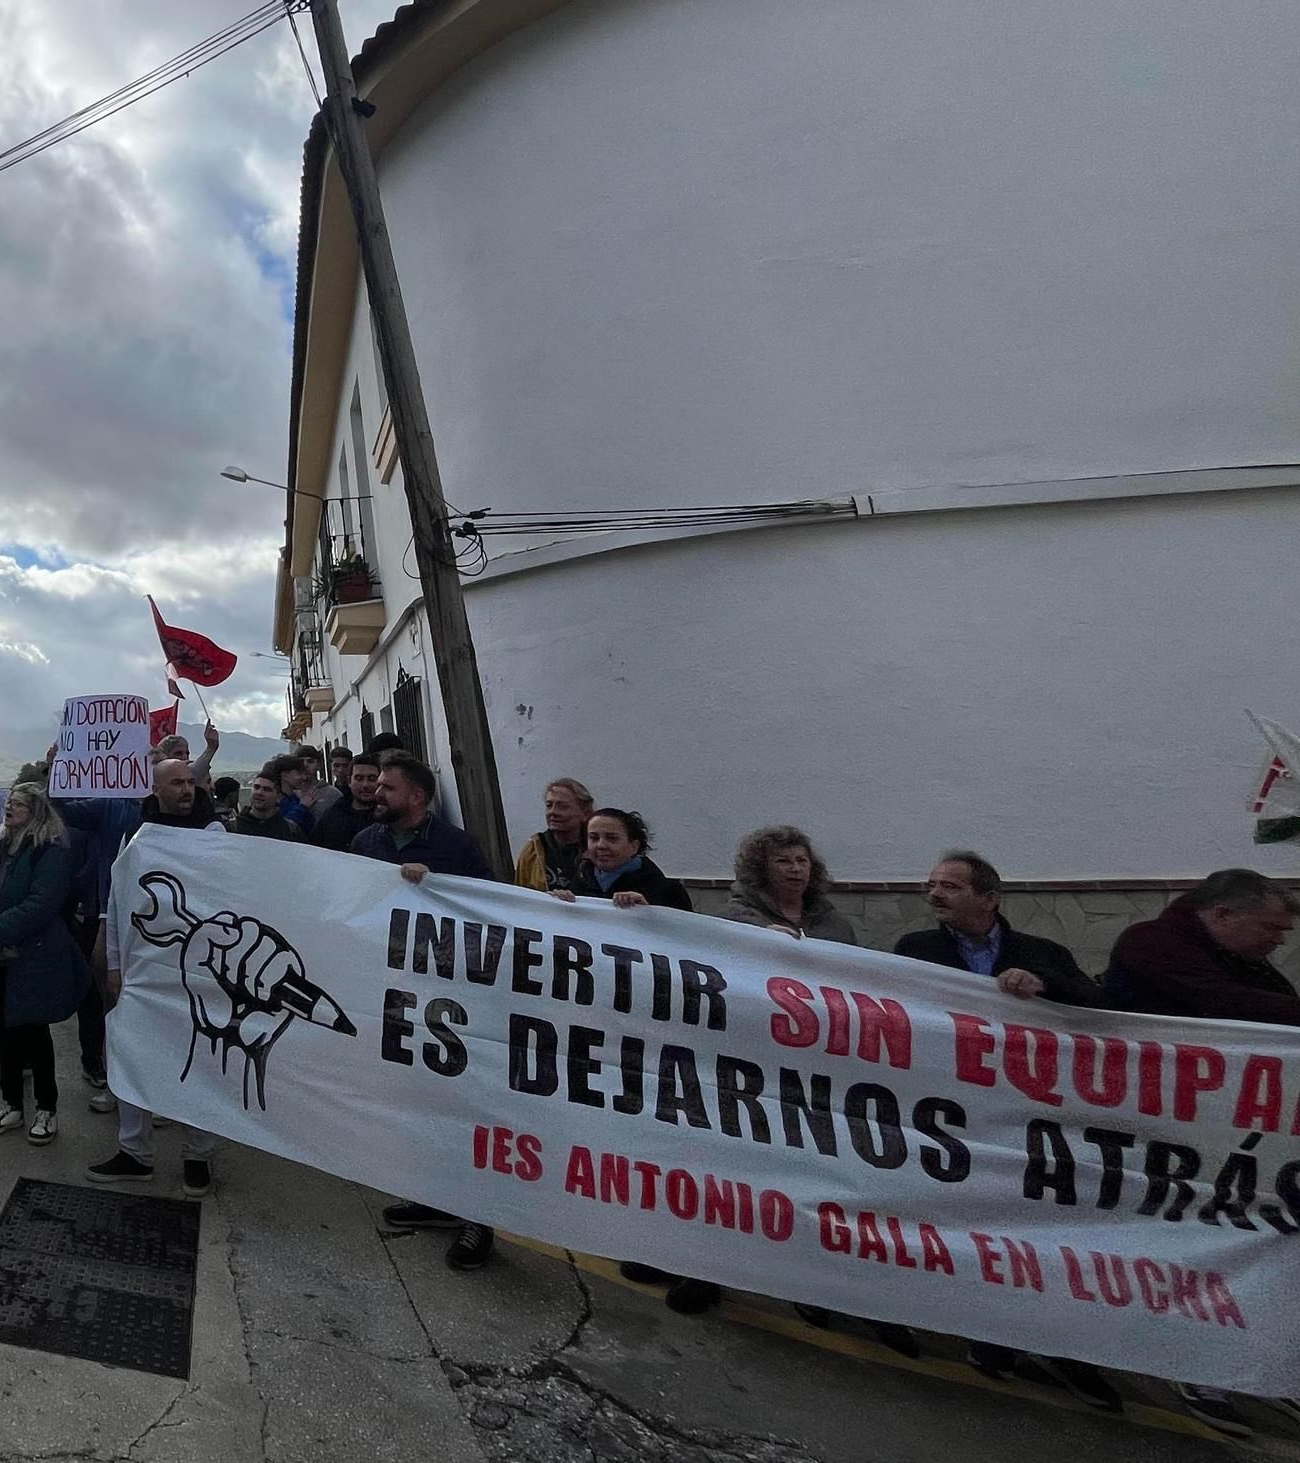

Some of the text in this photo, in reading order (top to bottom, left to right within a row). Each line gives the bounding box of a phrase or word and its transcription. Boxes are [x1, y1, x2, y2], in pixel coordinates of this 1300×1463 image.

[53, 751, 149, 790] FORMACIÓN
[77, 697, 147, 725] DOTACIÓN
[87, 729, 121, 751] HAY
[387, 908, 1300, 1136] INVERTIR SIN EQUIPA
[381, 988, 1300, 1235] ES DEJARNOS ATRÁS
[473, 1124, 1247, 1329] IES ANTONIO GALA EN LUCHA
